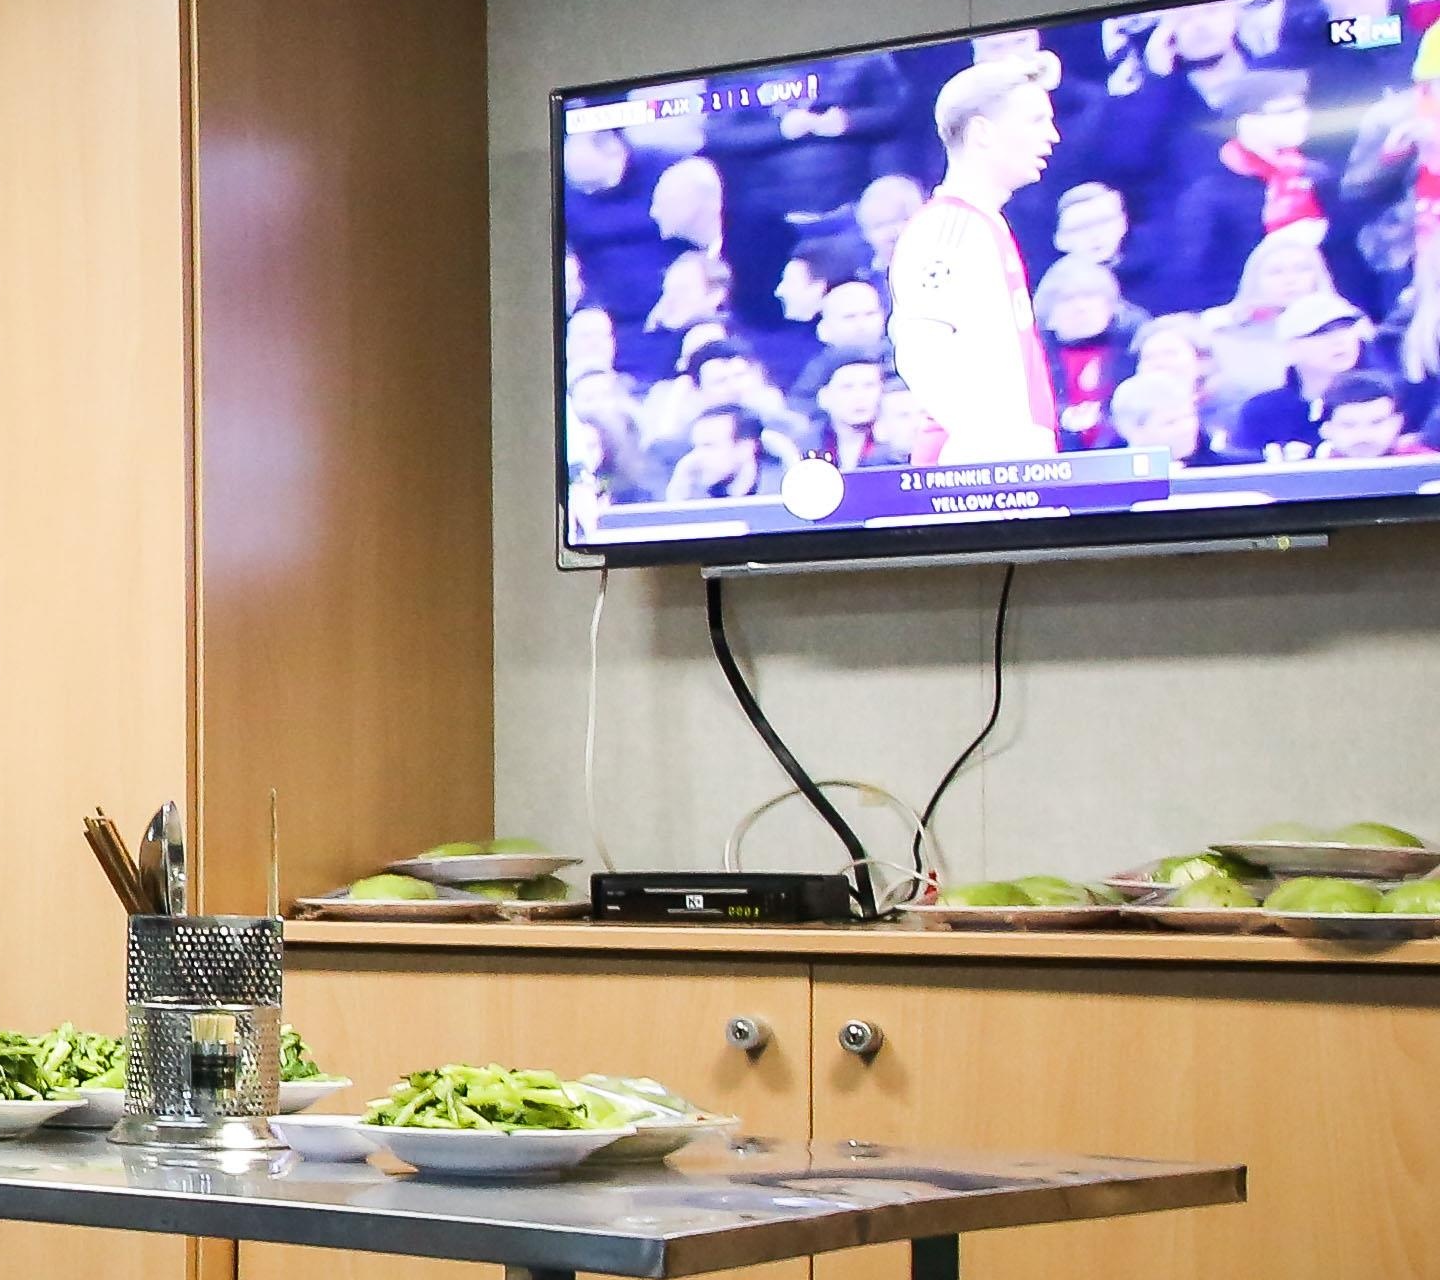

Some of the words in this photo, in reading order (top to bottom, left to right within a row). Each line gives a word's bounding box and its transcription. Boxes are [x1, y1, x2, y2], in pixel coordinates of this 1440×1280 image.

[900, 471, 923, 491] 21
[925, 467, 992, 489] FRENKIE
[995, 465, 1019, 484] DE
[1022, 461, 1072, 482] JONG
[932, 493, 993, 513] YELLOW
[995, 491, 1040, 509] CARD
